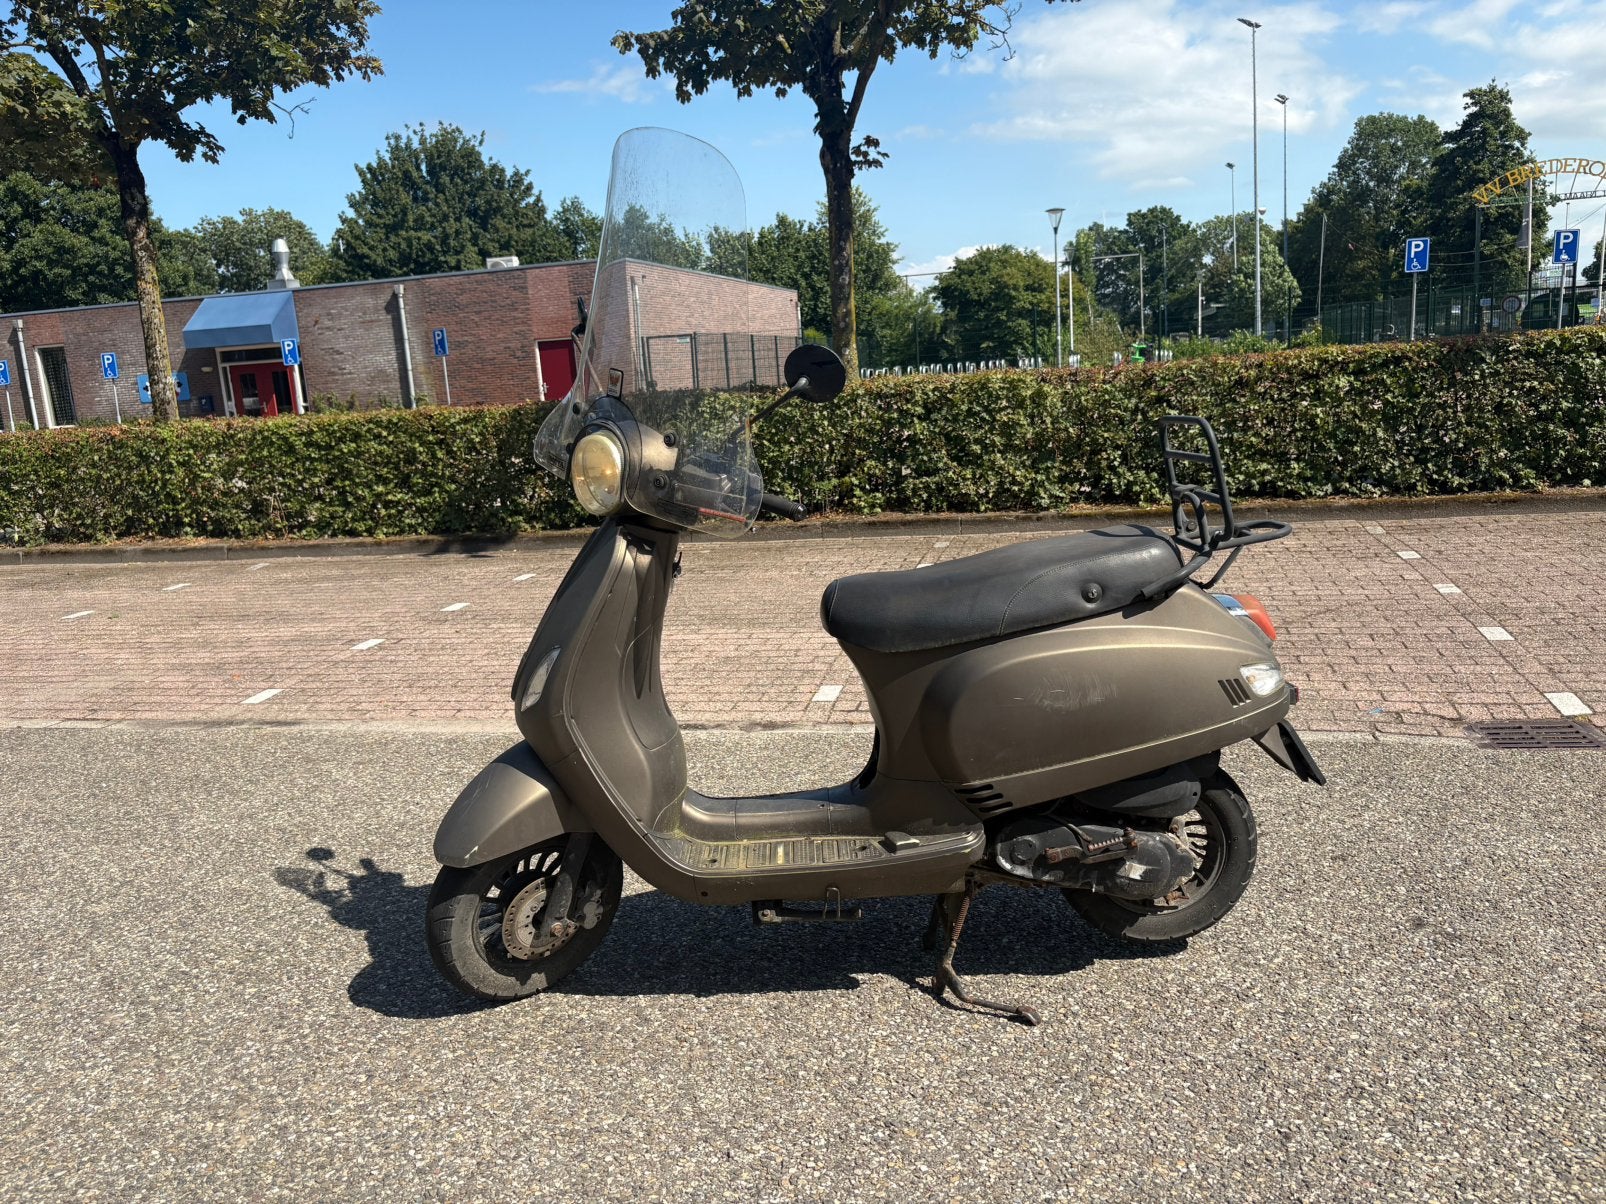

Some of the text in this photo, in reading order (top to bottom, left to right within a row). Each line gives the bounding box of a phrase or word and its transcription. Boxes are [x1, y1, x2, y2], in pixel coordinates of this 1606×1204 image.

[1472, 158, 1606, 204] VV BREDERO
[1560, 232, 1573, 249] P
[1411, 241, 1424, 258] P
[435, 331, 442, 345] P
[284, 341, 293, 355] P
[103, 355, 112, 368] P
